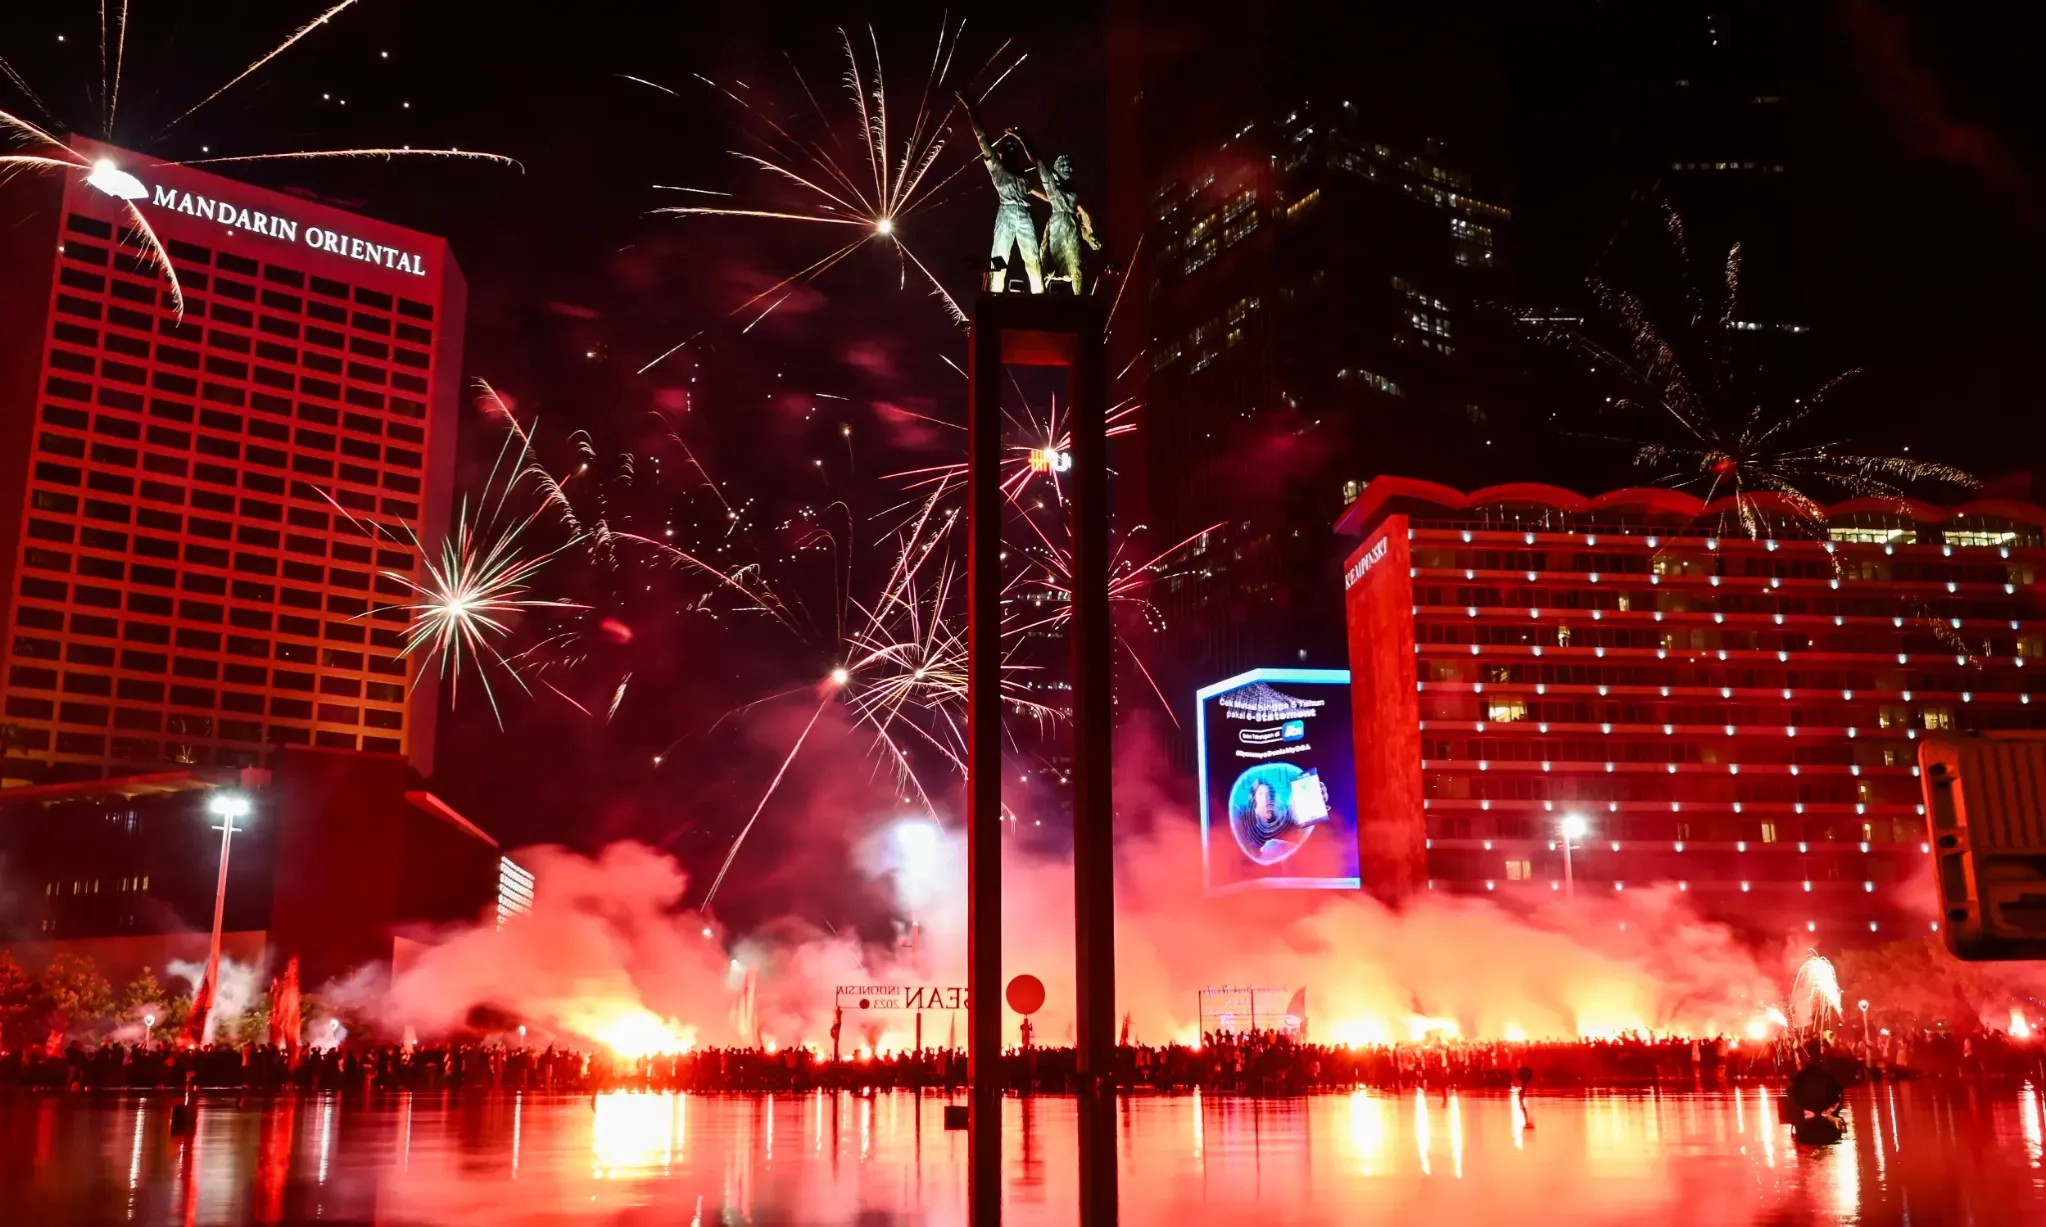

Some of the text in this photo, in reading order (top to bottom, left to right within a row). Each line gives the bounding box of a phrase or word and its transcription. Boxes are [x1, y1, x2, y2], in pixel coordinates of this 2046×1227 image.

[153, 184, 426, 276] MANDARIN ORIENTAL
[1290, 701, 1297, 709] 5
